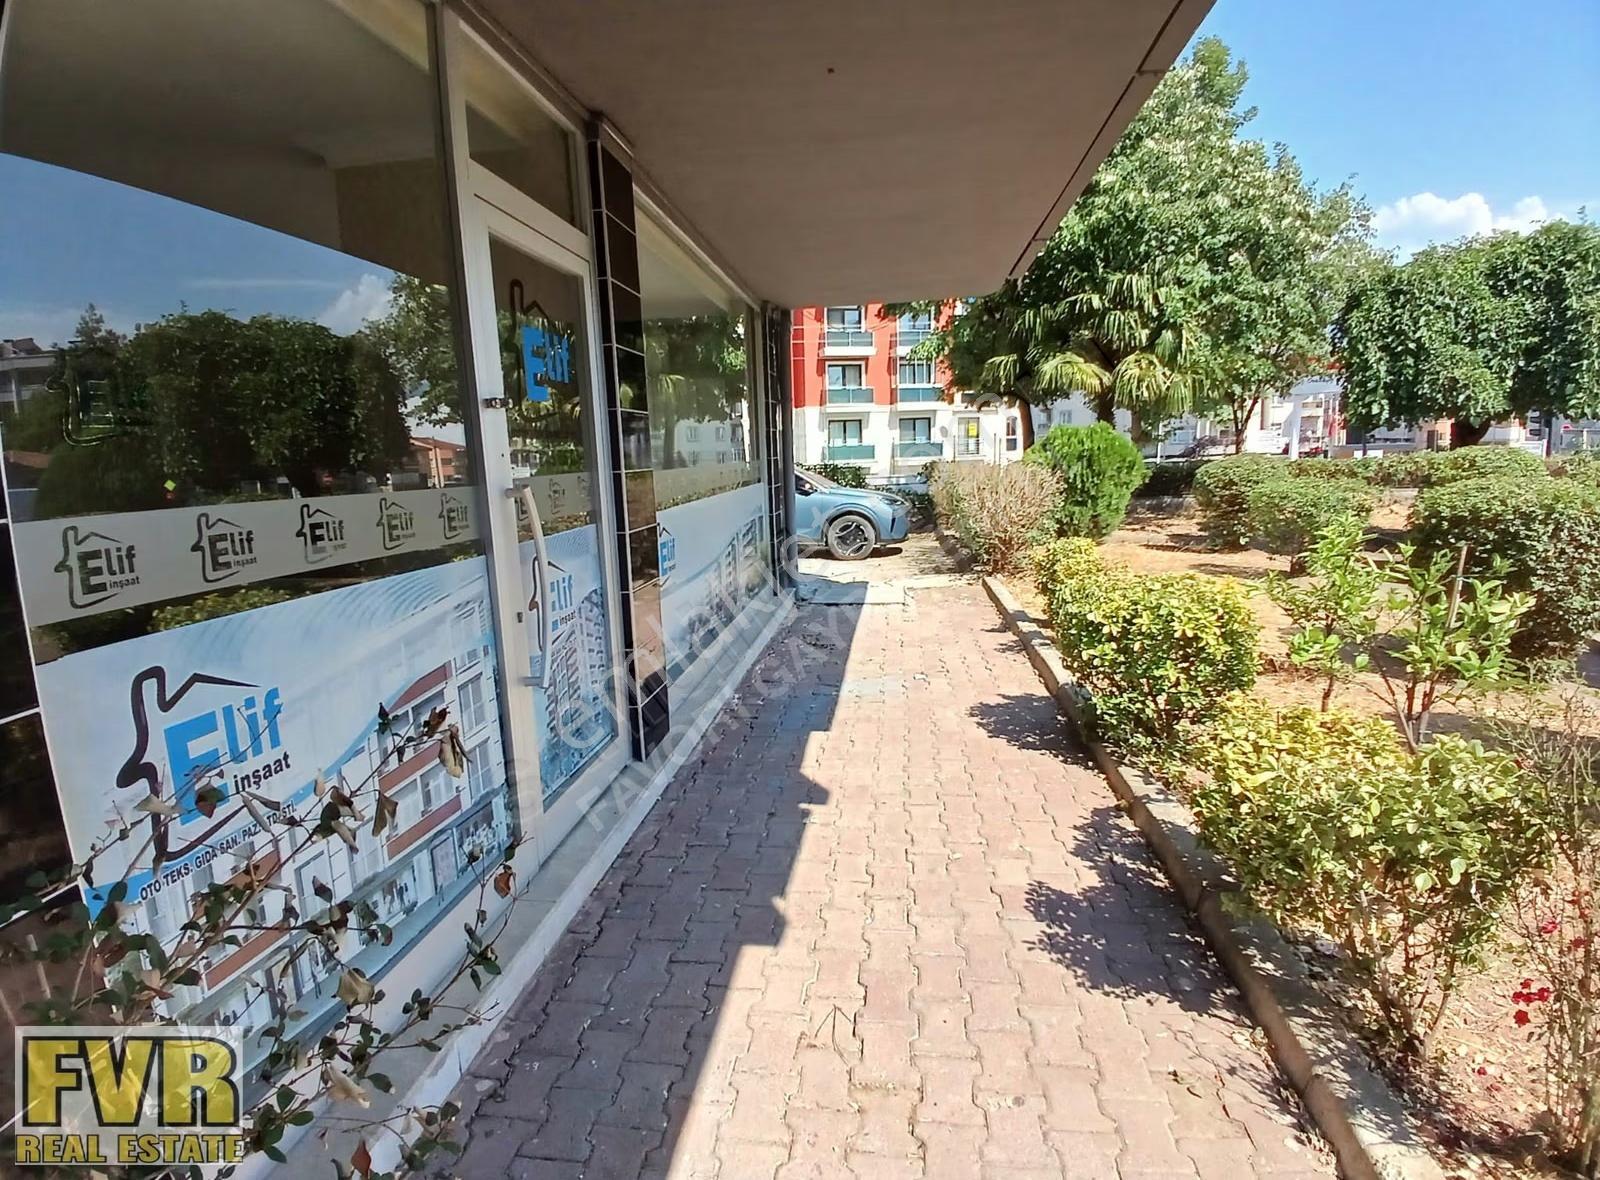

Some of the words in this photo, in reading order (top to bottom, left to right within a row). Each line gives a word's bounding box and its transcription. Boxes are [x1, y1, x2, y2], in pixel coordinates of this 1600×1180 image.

[309, 520, 344, 554] Elif
[387, 512, 413, 542] Elif
[446, 506, 468, 532] Elif
[77, 545, 136, 595] Elif
[208, 530, 254, 572] Elif
[109, 575, 140, 589] inşaat
[163, 687, 281, 826] Elif
[233, 751, 291, 793] inşaat
[140, 879, 162, 901] OTO
[163, 865, 193, 889] TEKS.
[195, 848, 219, 869] GIDA
[219, 837, 241, 853] SAN.
